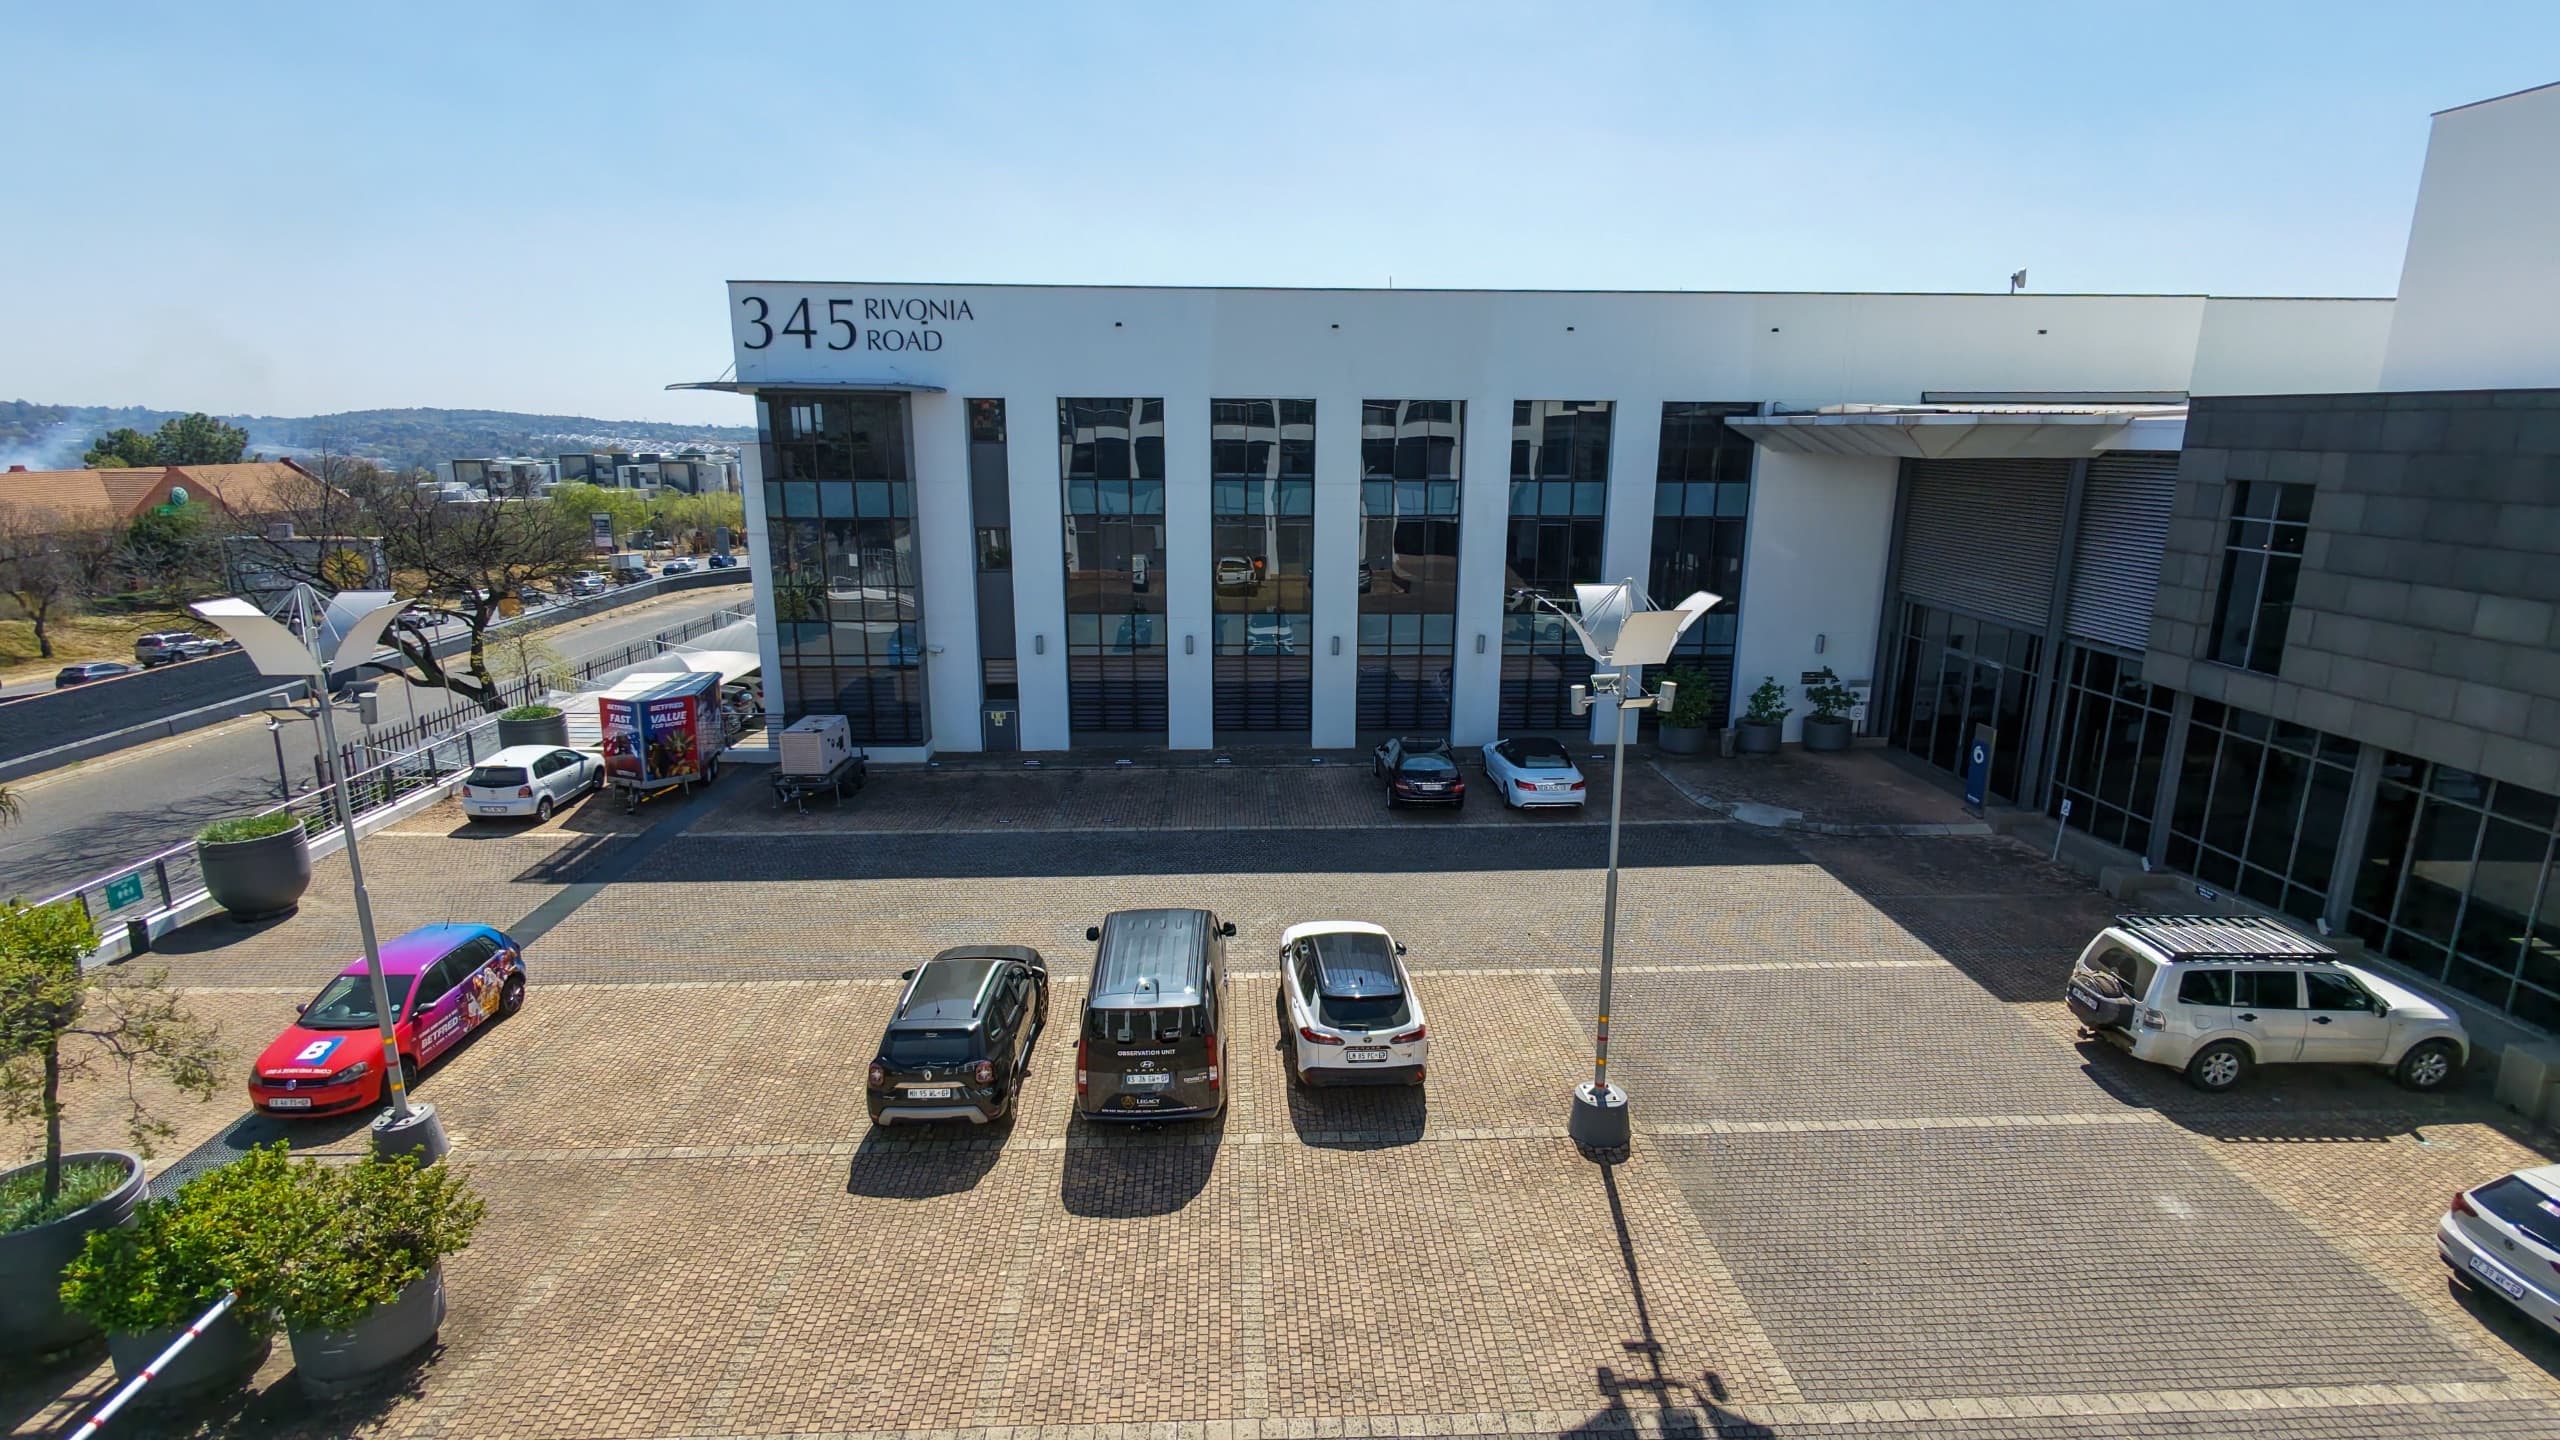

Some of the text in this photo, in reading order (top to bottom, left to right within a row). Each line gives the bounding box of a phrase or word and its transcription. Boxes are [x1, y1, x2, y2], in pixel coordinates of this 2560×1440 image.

[864, 298, 974, 321] RIVONIA
[742, 297, 857, 350] 345
[867, 329, 942, 351] ROAD
[610, 713, 631, 724] FAST
[650, 711, 687, 724] VALUE
[1973, 745, 1984, 764] 6
[421, 1016, 459, 1049] BETFRED
[295, 1040, 332, 1060] B
